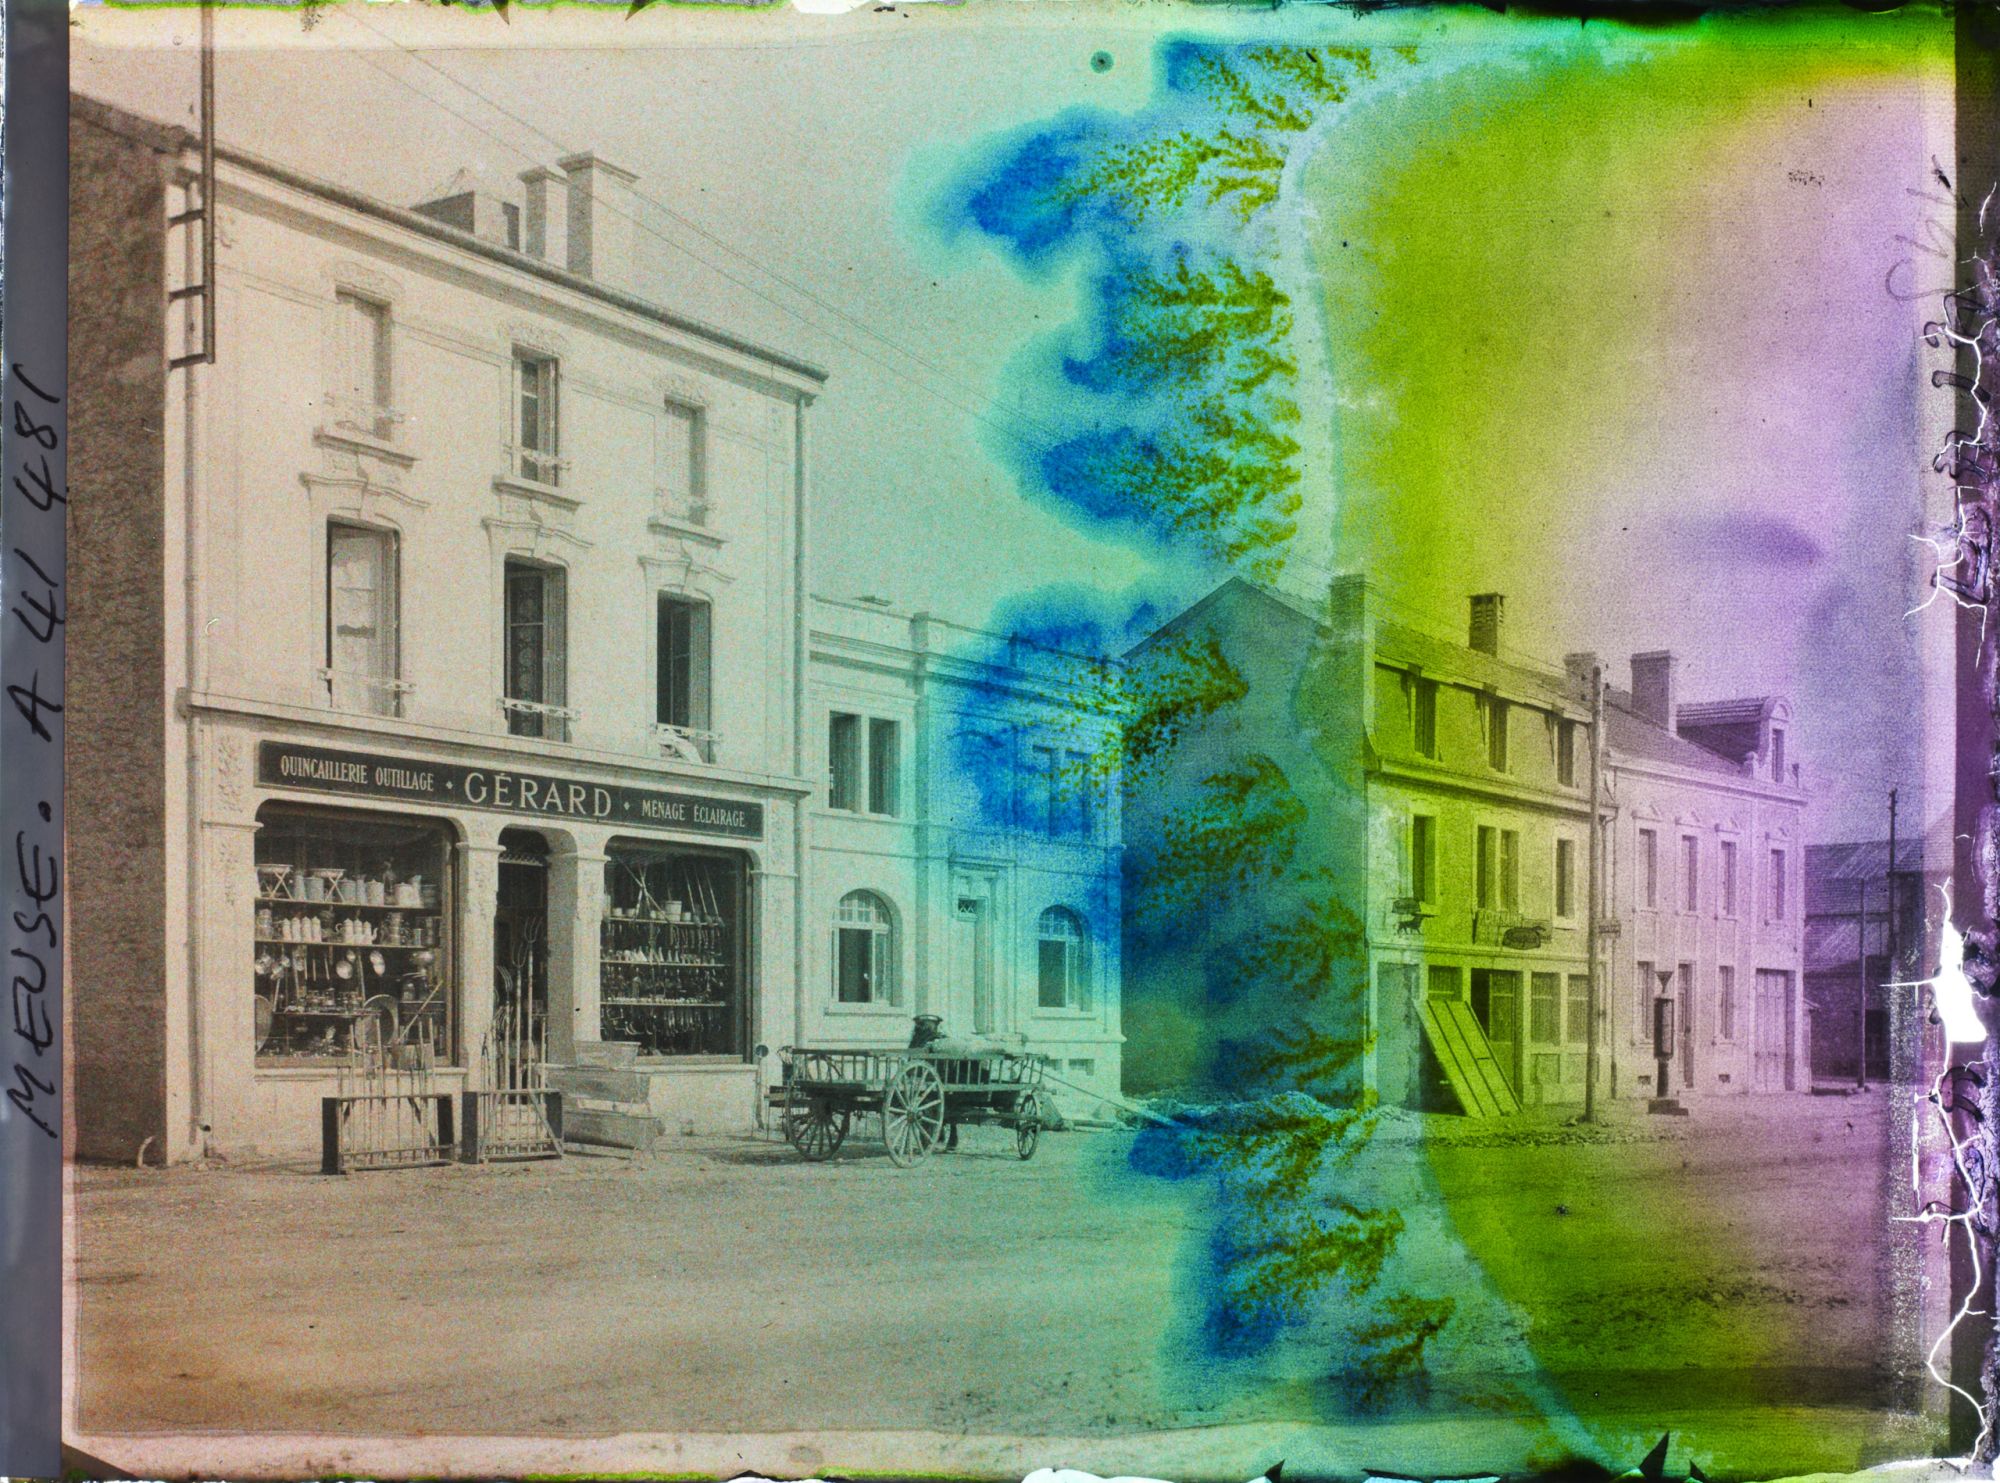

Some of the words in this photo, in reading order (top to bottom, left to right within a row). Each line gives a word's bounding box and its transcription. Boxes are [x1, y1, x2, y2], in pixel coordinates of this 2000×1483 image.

[7, 669, 63, 742] A
[280, 755, 368, 785] QUINCAILLERIE
[375, 767, 434, 792] OUTILLAGE
[464, 772, 612, 817] GÉRARD
